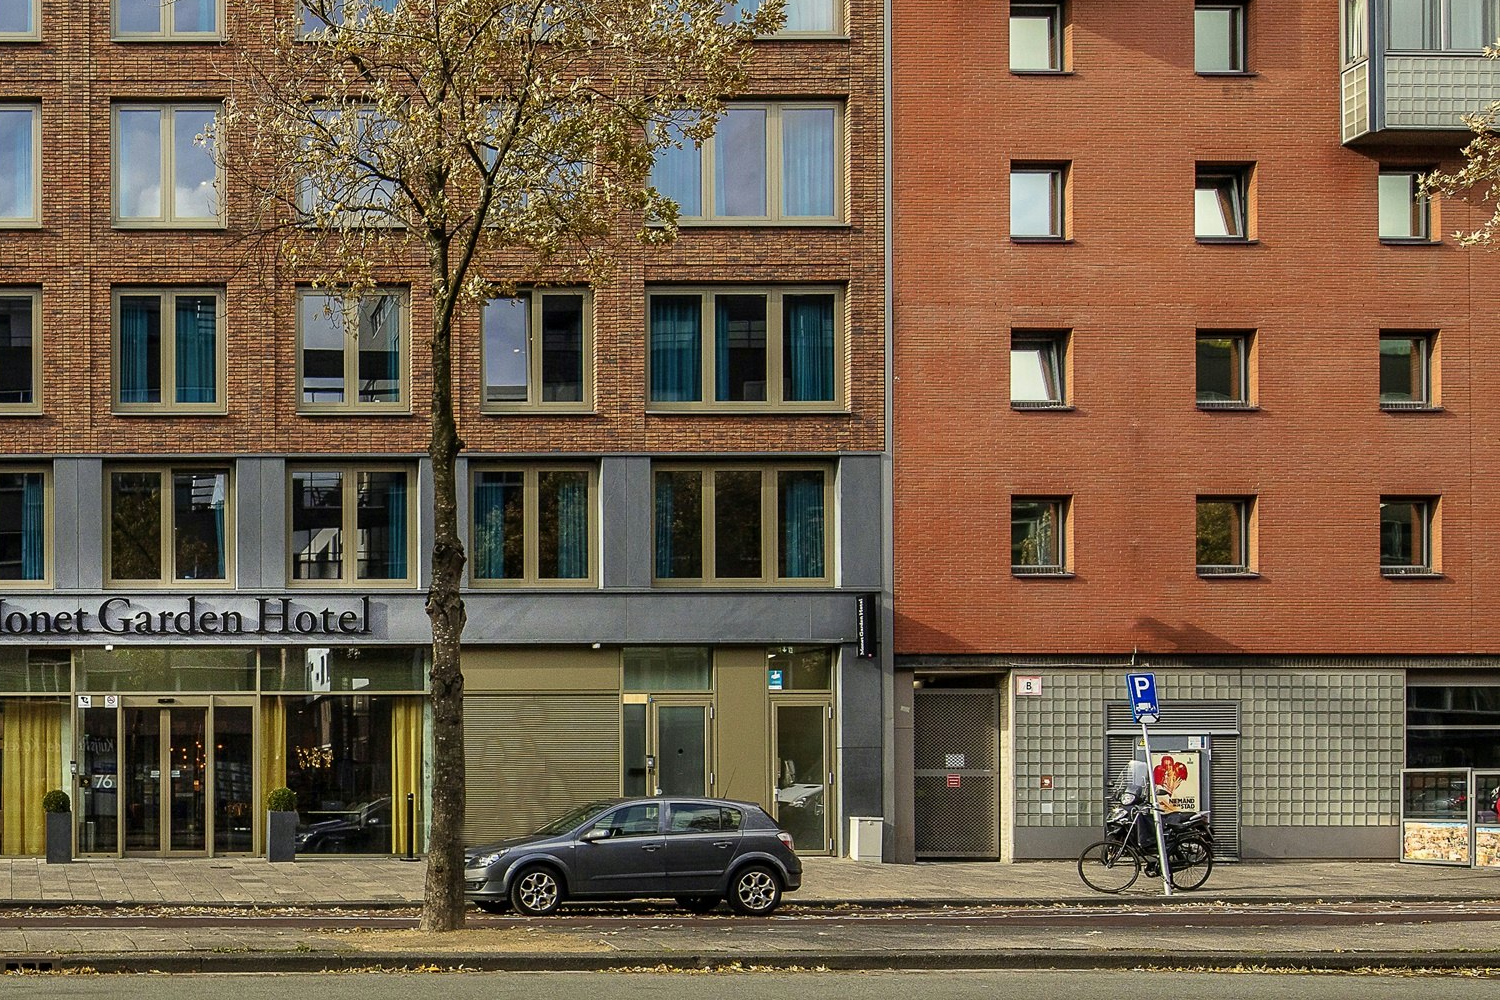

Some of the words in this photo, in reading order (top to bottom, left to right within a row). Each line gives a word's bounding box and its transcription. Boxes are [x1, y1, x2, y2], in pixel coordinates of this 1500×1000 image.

[98, 596, 243, 634] Garden
[255, 596, 372, 634] Hotel
[1026, 681, 1032, 690] B
[1134, 677, 1150, 698] P
[95, 775, 113, 788] 76
